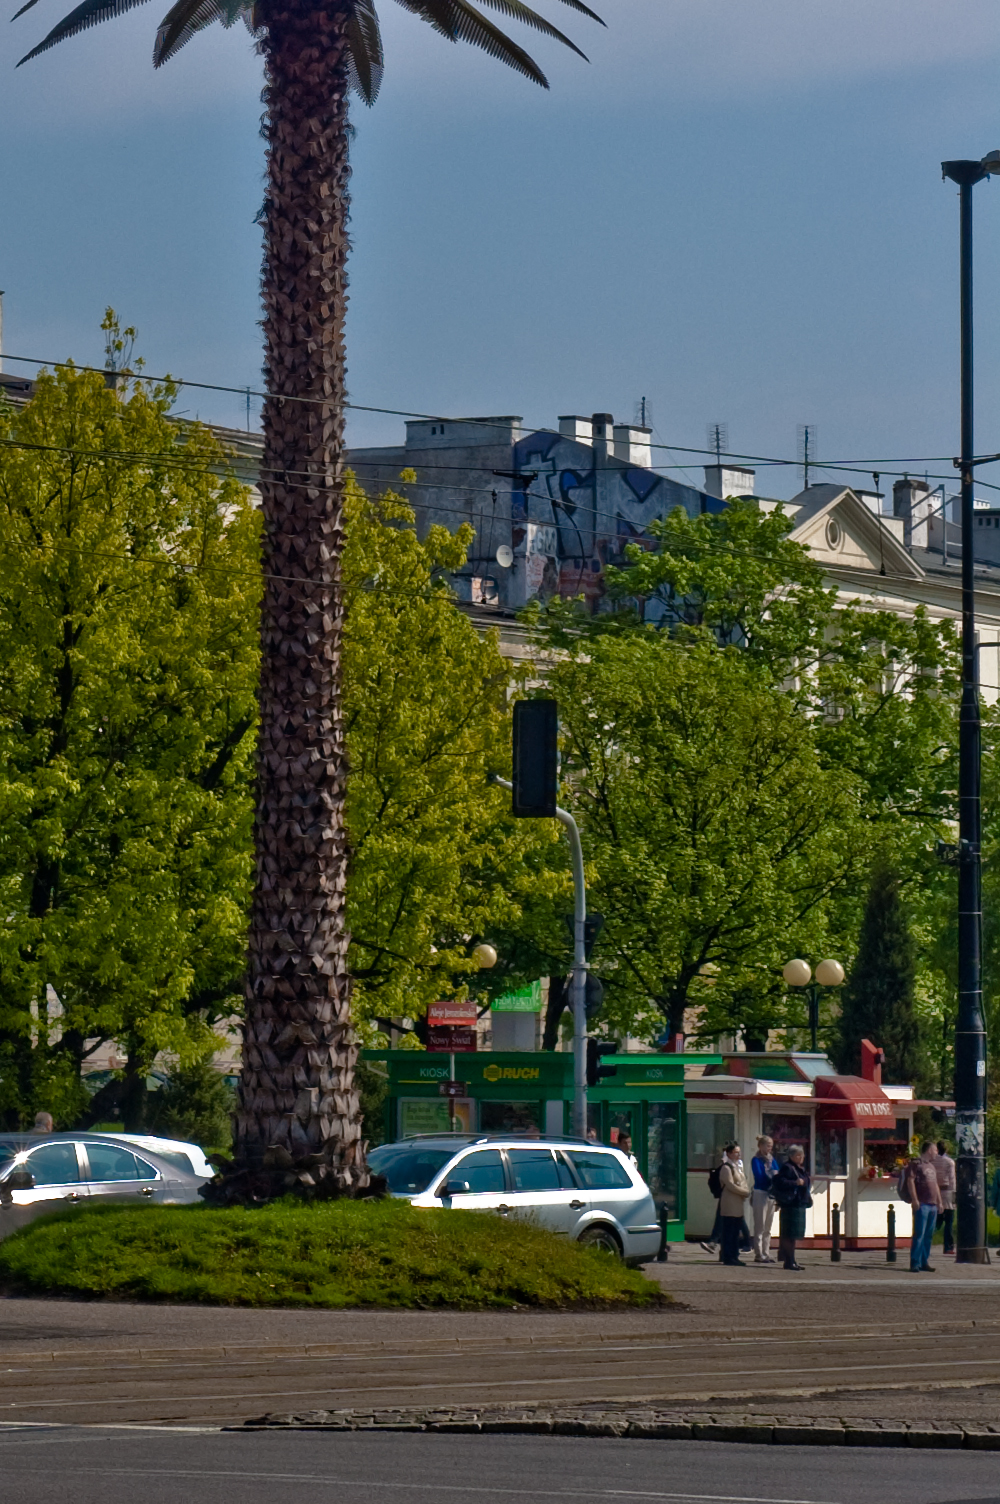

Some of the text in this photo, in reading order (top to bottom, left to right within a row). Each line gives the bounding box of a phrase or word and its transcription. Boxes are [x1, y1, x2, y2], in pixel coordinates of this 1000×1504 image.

[430, 1036, 449, 1047] Nowy
[419, 1067, 540, 1079] KIOSK RUCH
